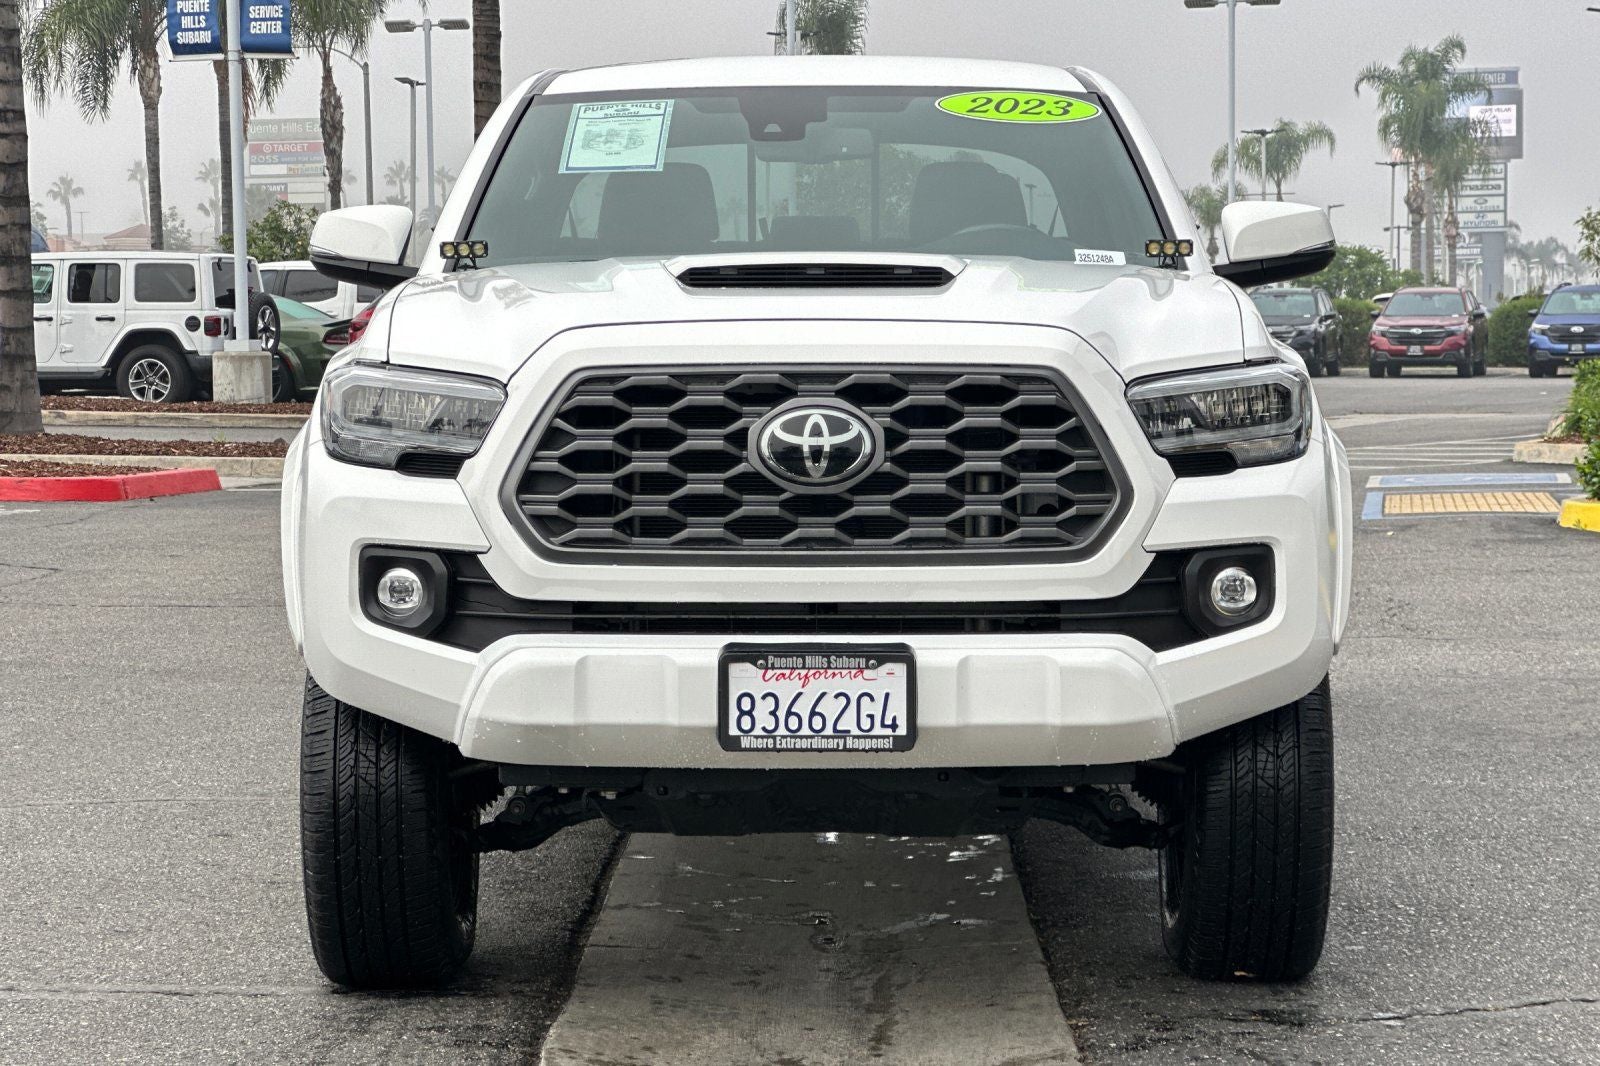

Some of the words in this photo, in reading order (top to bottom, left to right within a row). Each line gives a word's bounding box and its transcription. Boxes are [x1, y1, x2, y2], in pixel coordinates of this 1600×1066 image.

[177, 0, 209, 13] PUENTE
[249, 5, 283, 18] SERVICE
[181, 15, 206, 28] HILLS
[250, 21, 282, 34] CENTER
[177, 31, 211, 44] SUBARU
[583, 104, 626, 114] PUENTE
[966, 96, 1074, 117] 2023
[250, 124, 278, 134] uente
[281, 122, 303, 132] Hills
[273, 144, 308, 152] TARGET
[251, 155, 279, 163] ROSS
[768, 656, 801, 669] Puente
[805, 656, 827, 669] Hills
[829, 656, 866, 669] Subaru
[761, 668, 877, 688] California
[736, 691, 899, 735] 83662G4
[740, 736, 774, 749] Where
[776, 736, 844, 750] Extraordinary
[846, 736, 893, 750] Happens!
